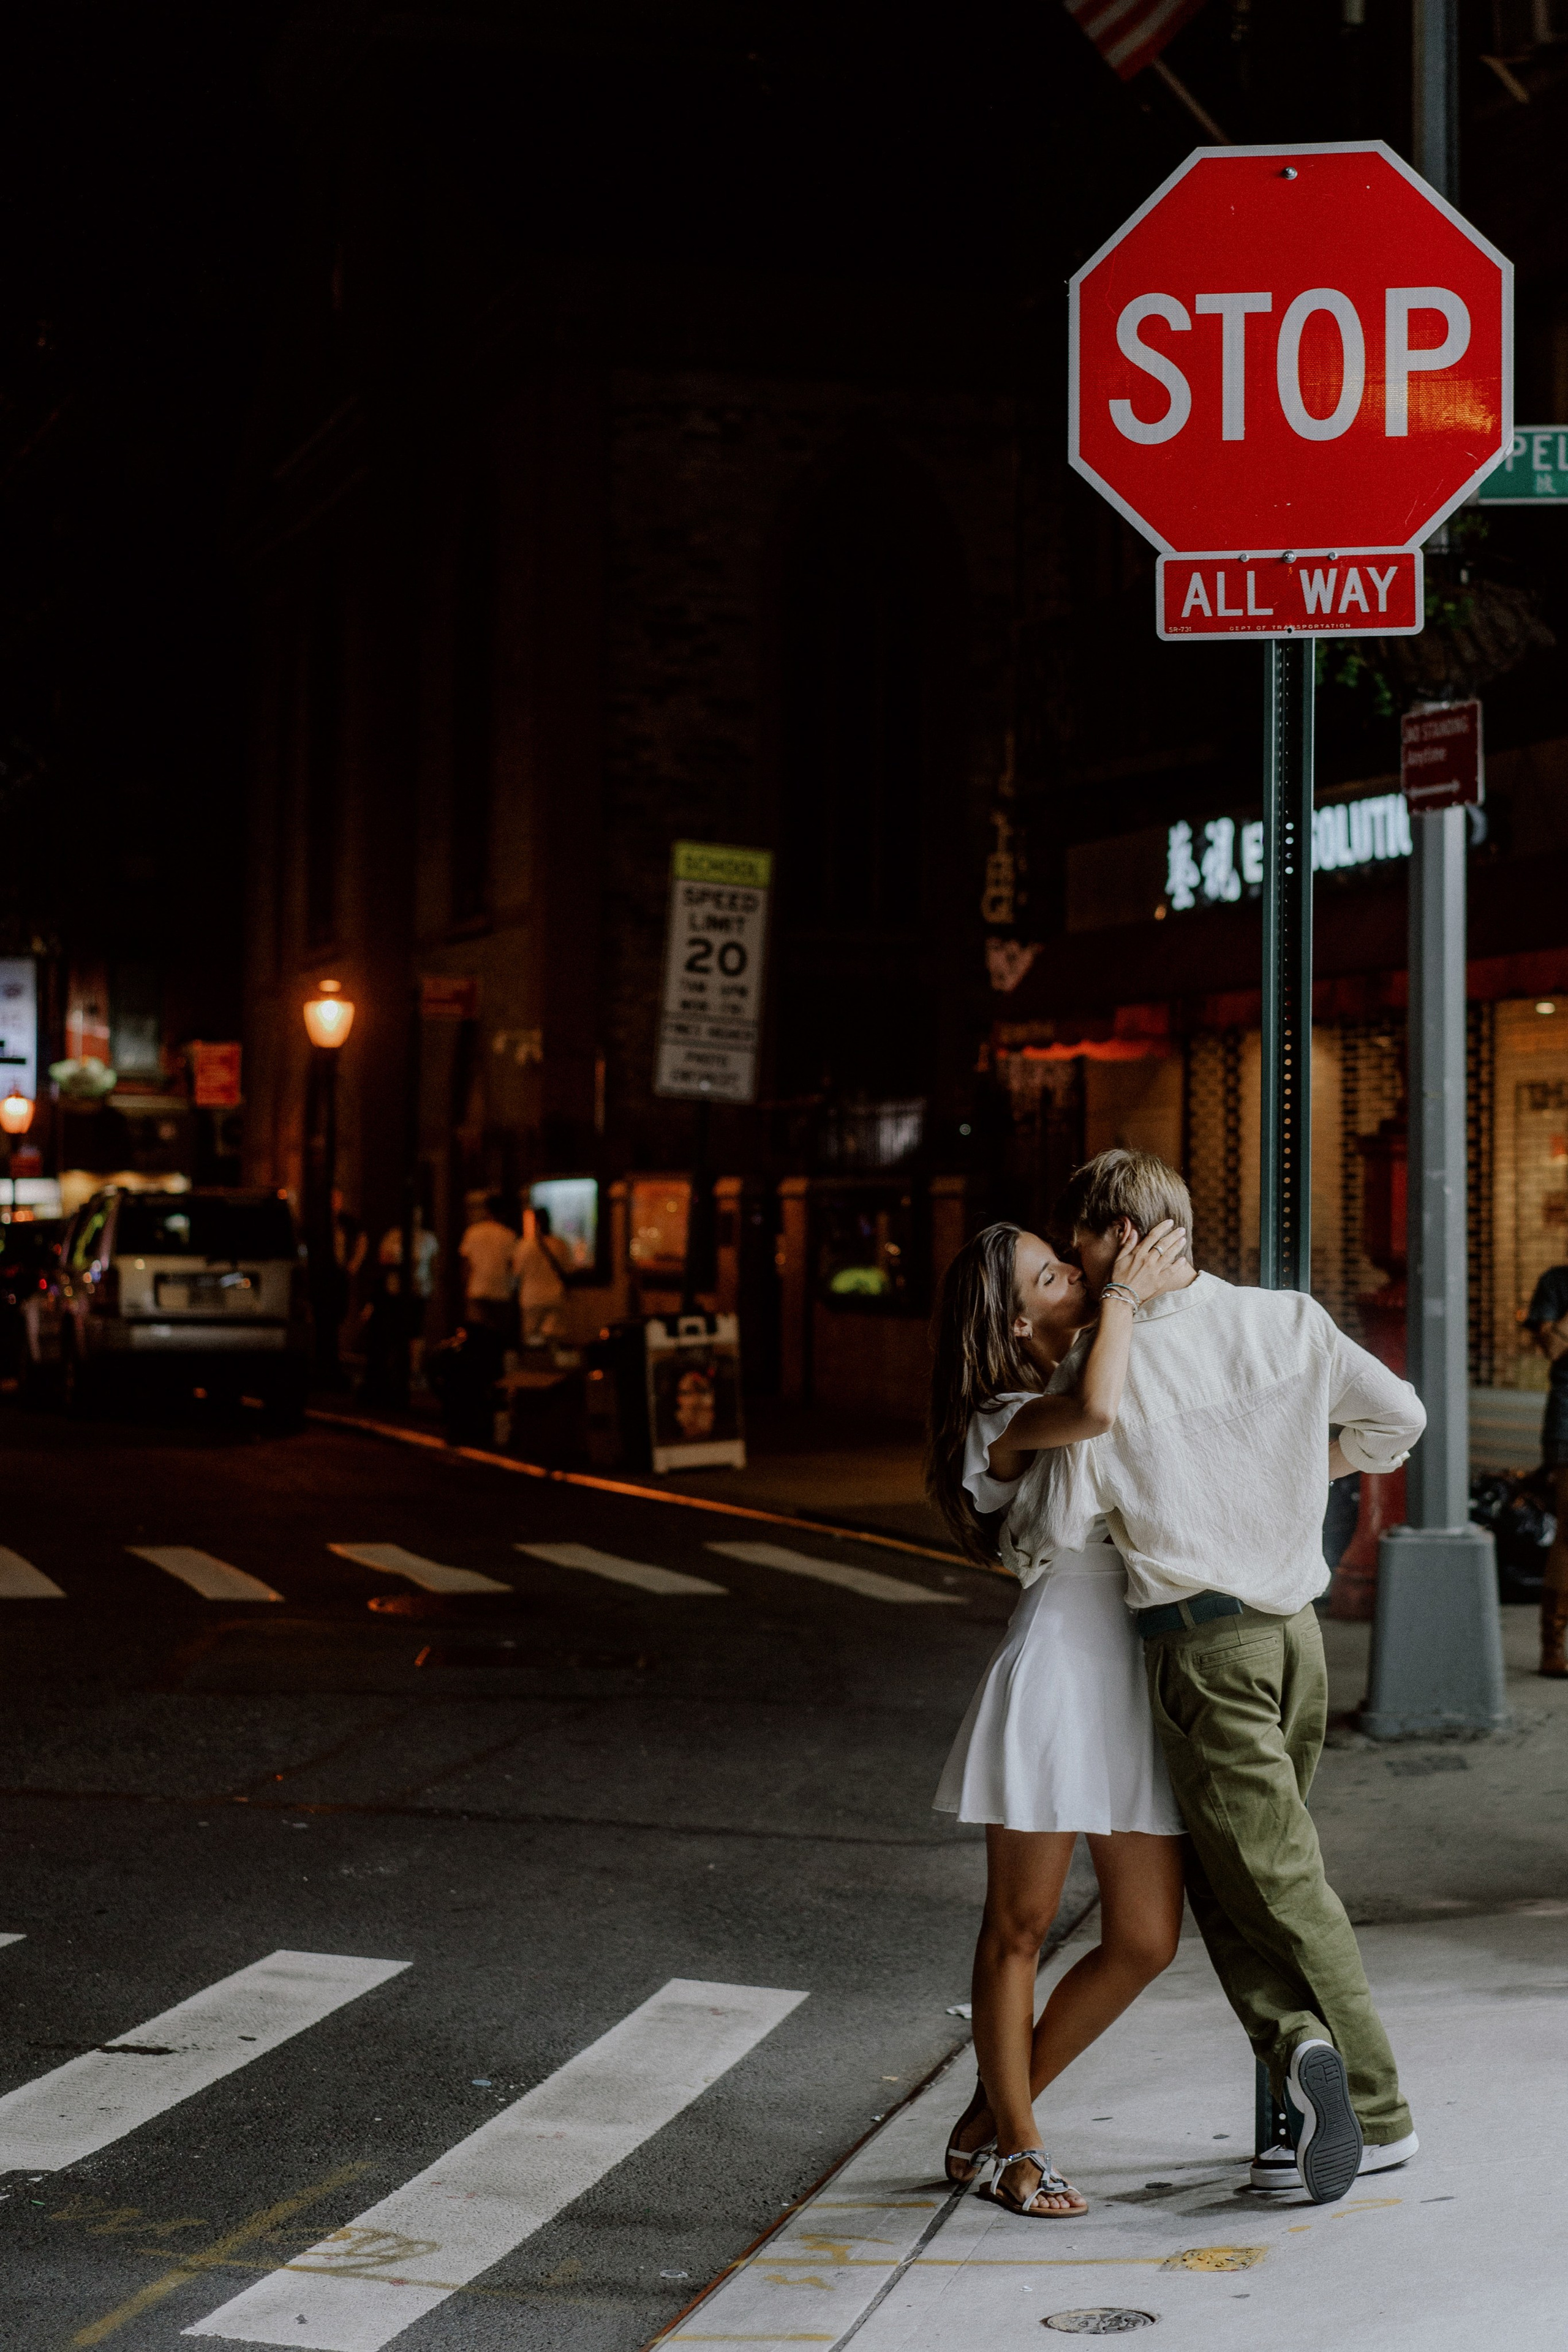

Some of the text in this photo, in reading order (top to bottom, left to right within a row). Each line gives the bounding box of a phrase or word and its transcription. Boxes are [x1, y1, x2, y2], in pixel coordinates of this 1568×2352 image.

[1108, 286, 1472, 445] STOP
[1181, 566, 1398, 617] ALL WAY
[684, 887, 761, 914] SPEED
[688, 912, 747, 934] LIMIT
[685, 938, 747, 977] 20
